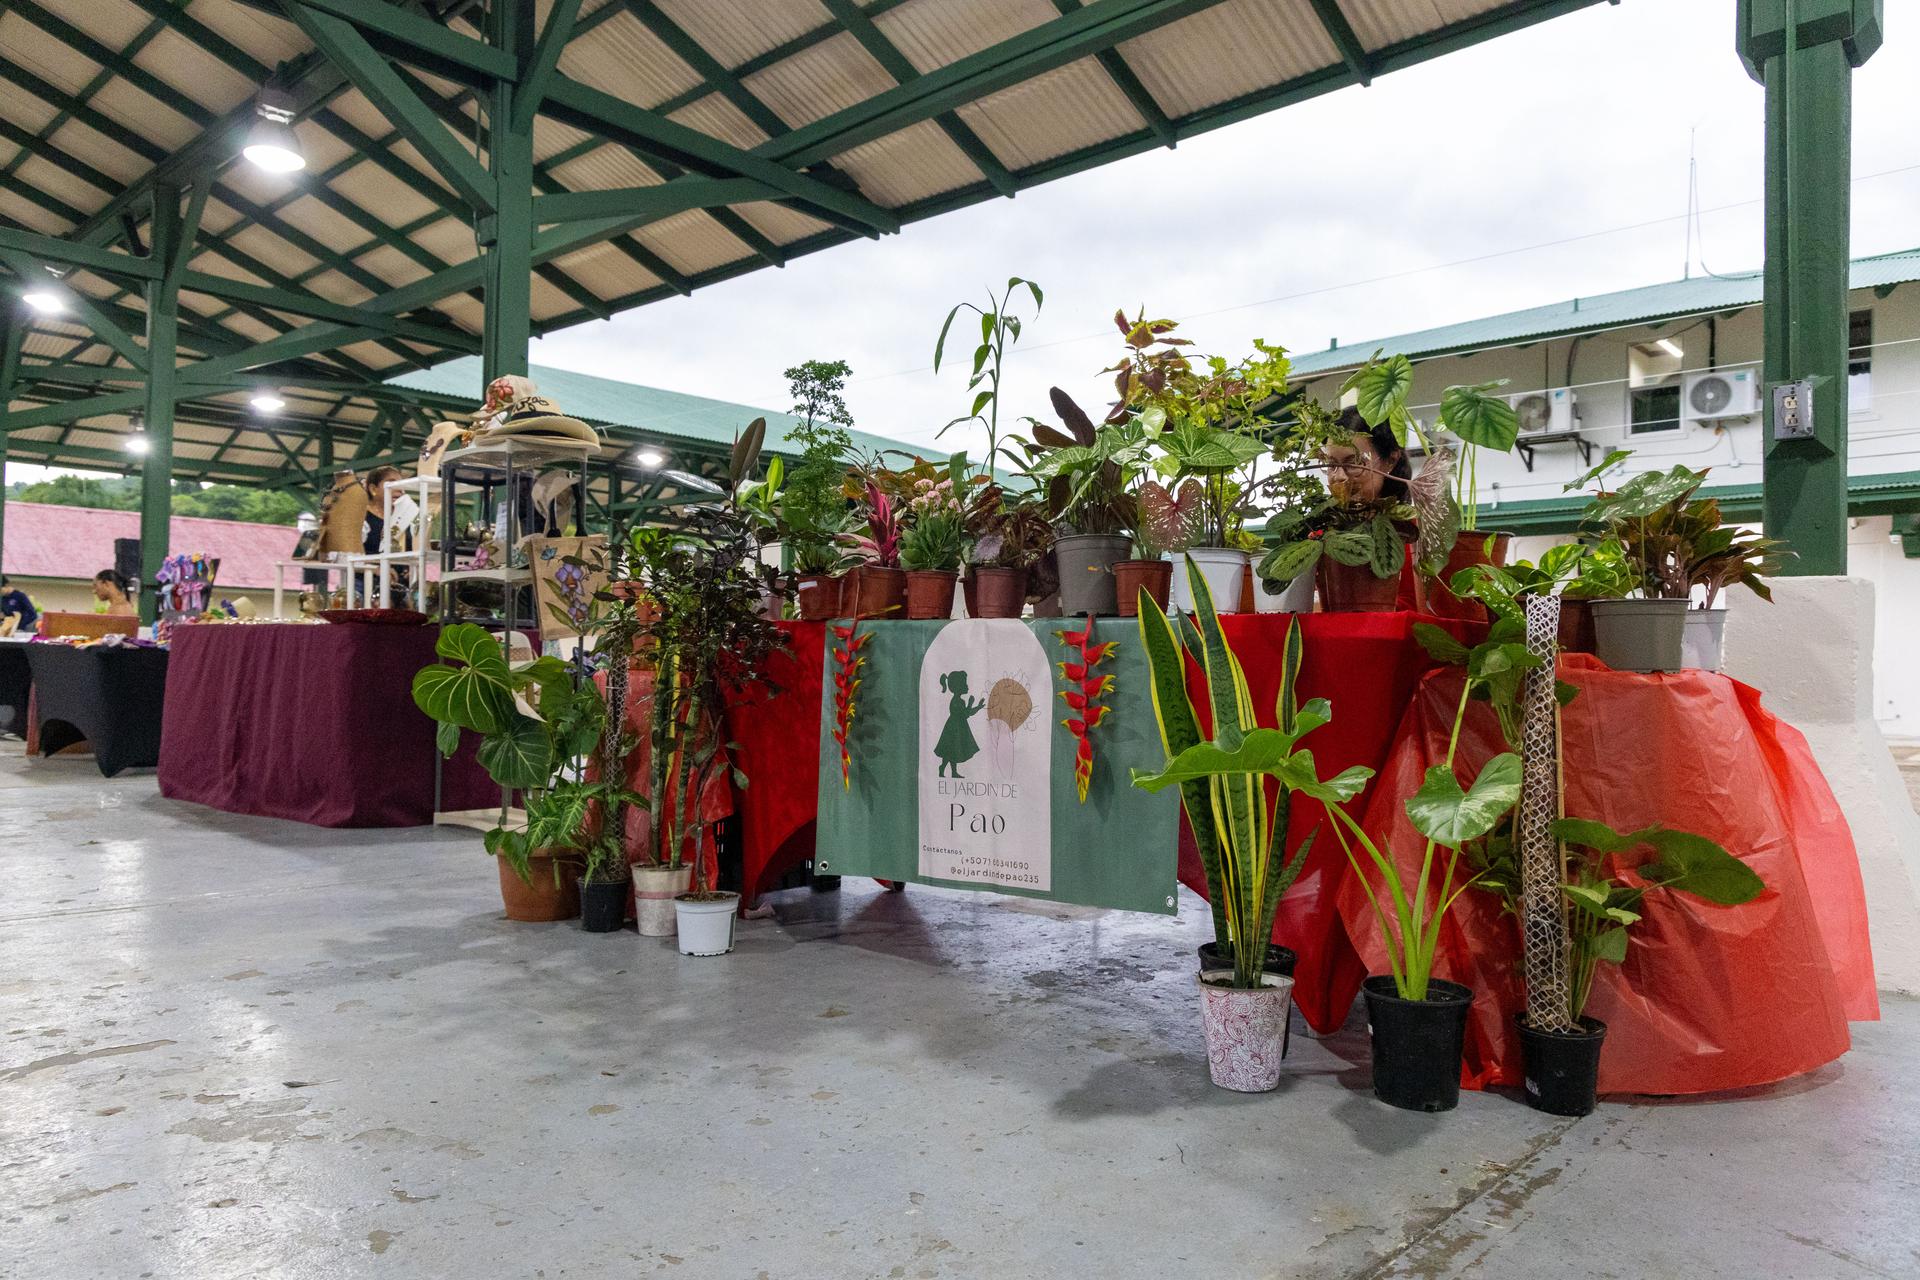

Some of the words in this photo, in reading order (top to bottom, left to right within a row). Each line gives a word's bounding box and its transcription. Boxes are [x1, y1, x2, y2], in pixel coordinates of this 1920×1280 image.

[938, 780, 951, 795] EL
[953, 781, 999, 799] JARDIN
[1001, 783, 1018, 799] DE
[950, 803, 1006, 835] Pao
